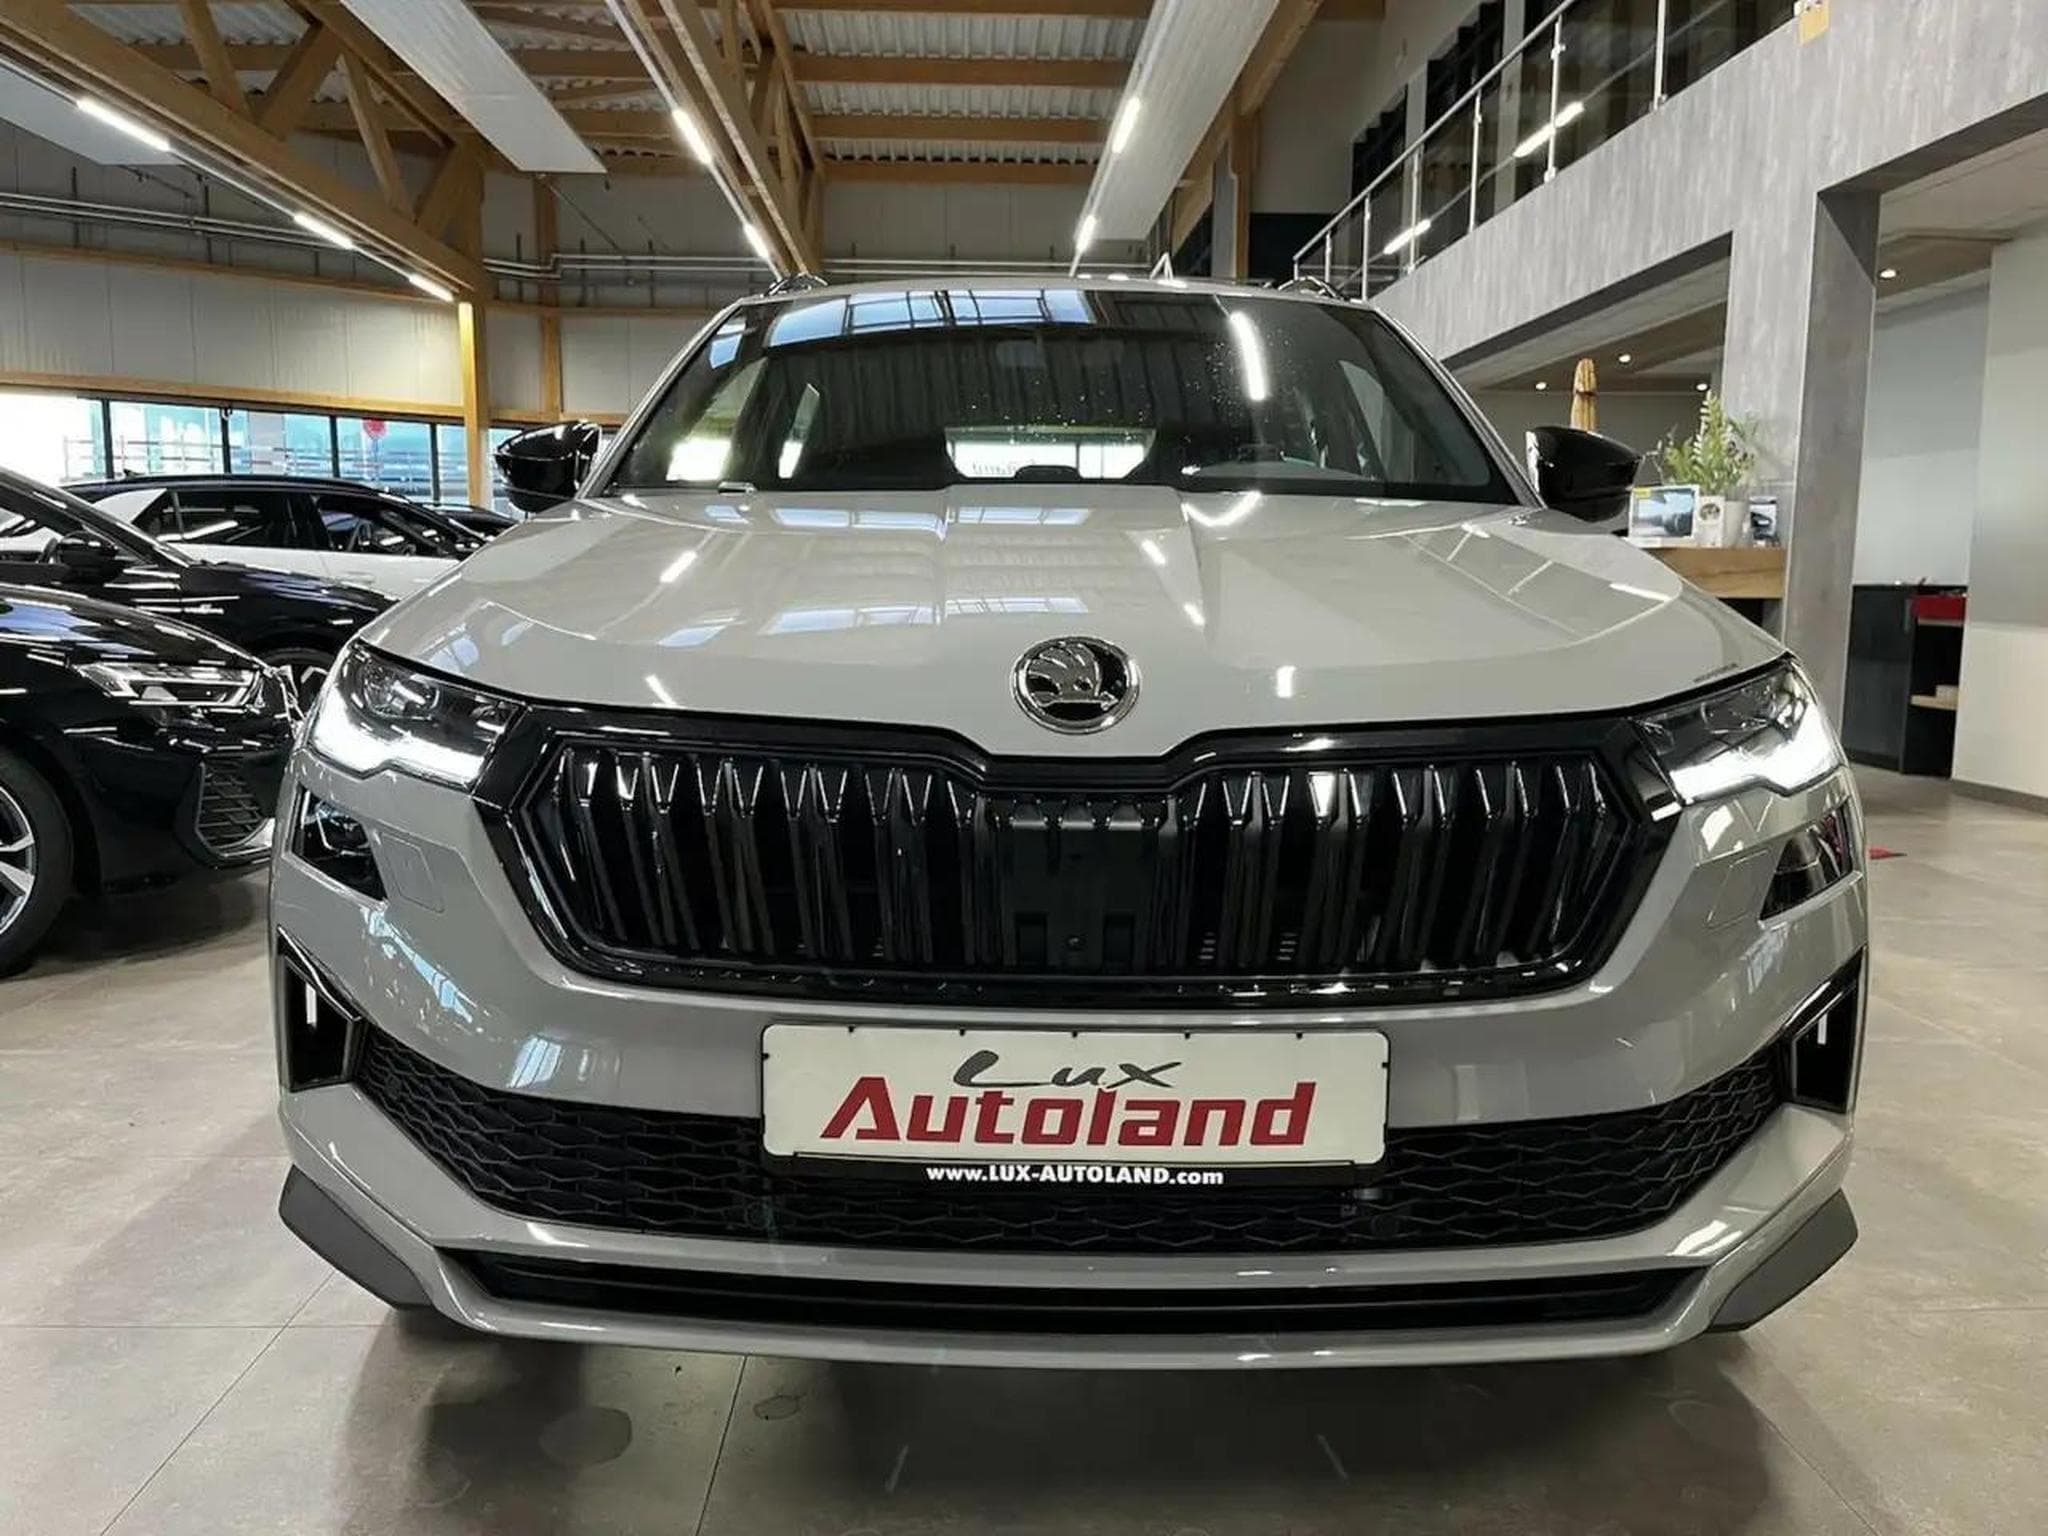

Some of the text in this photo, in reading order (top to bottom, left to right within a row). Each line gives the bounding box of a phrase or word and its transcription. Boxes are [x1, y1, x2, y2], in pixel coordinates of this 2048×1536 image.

[953, 1049, 1182, 1088] Lux
[820, 1076, 1317, 1147] Autoland
[926, 1163, 1224, 1186] www.LUX-AUTOLAND.com
